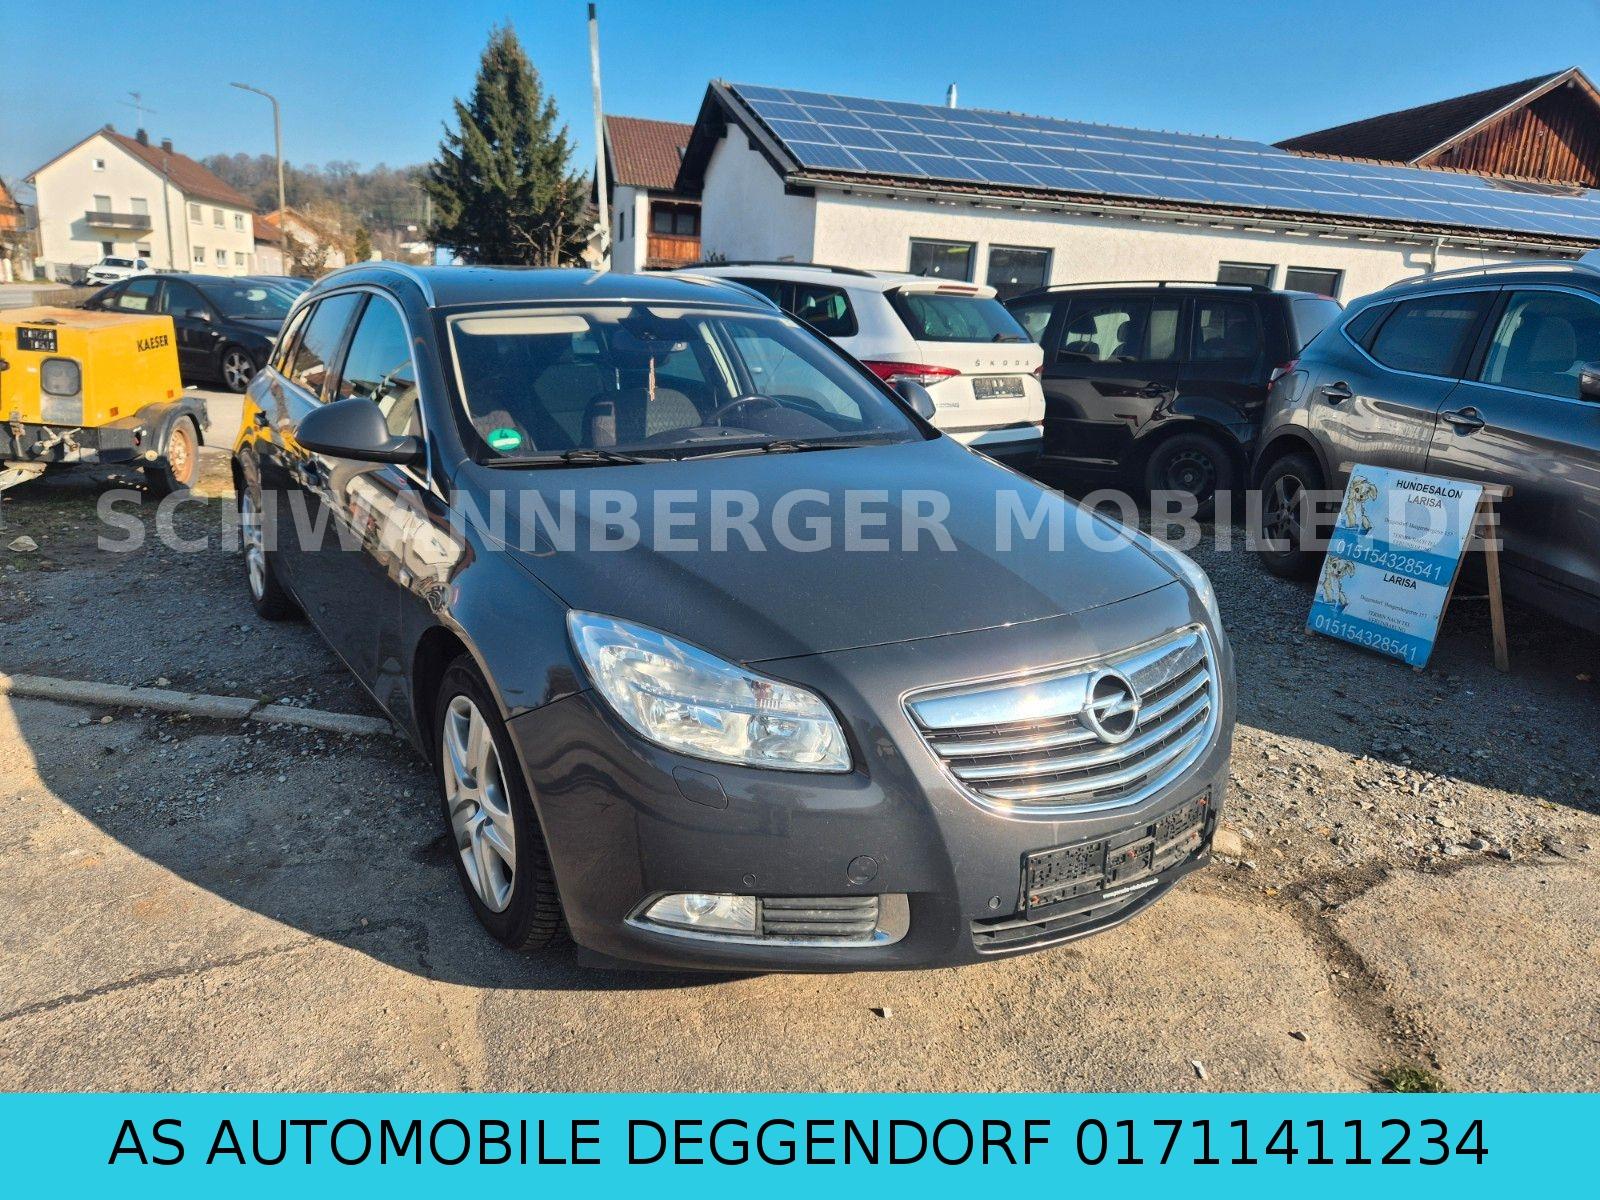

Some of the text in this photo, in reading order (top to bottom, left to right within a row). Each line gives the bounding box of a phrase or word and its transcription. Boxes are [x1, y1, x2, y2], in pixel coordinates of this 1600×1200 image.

[136, 334, 169, 353] KAESER
[1396, 479, 1463, 500] HUNDESALON
[1407, 494, 1443, 509] LARISA
[1336, 540, 1443, 581] 015154328541
[1383, 572, 1417, 590] LARISA
[1314, 614, 1417, 661] 015154328541
